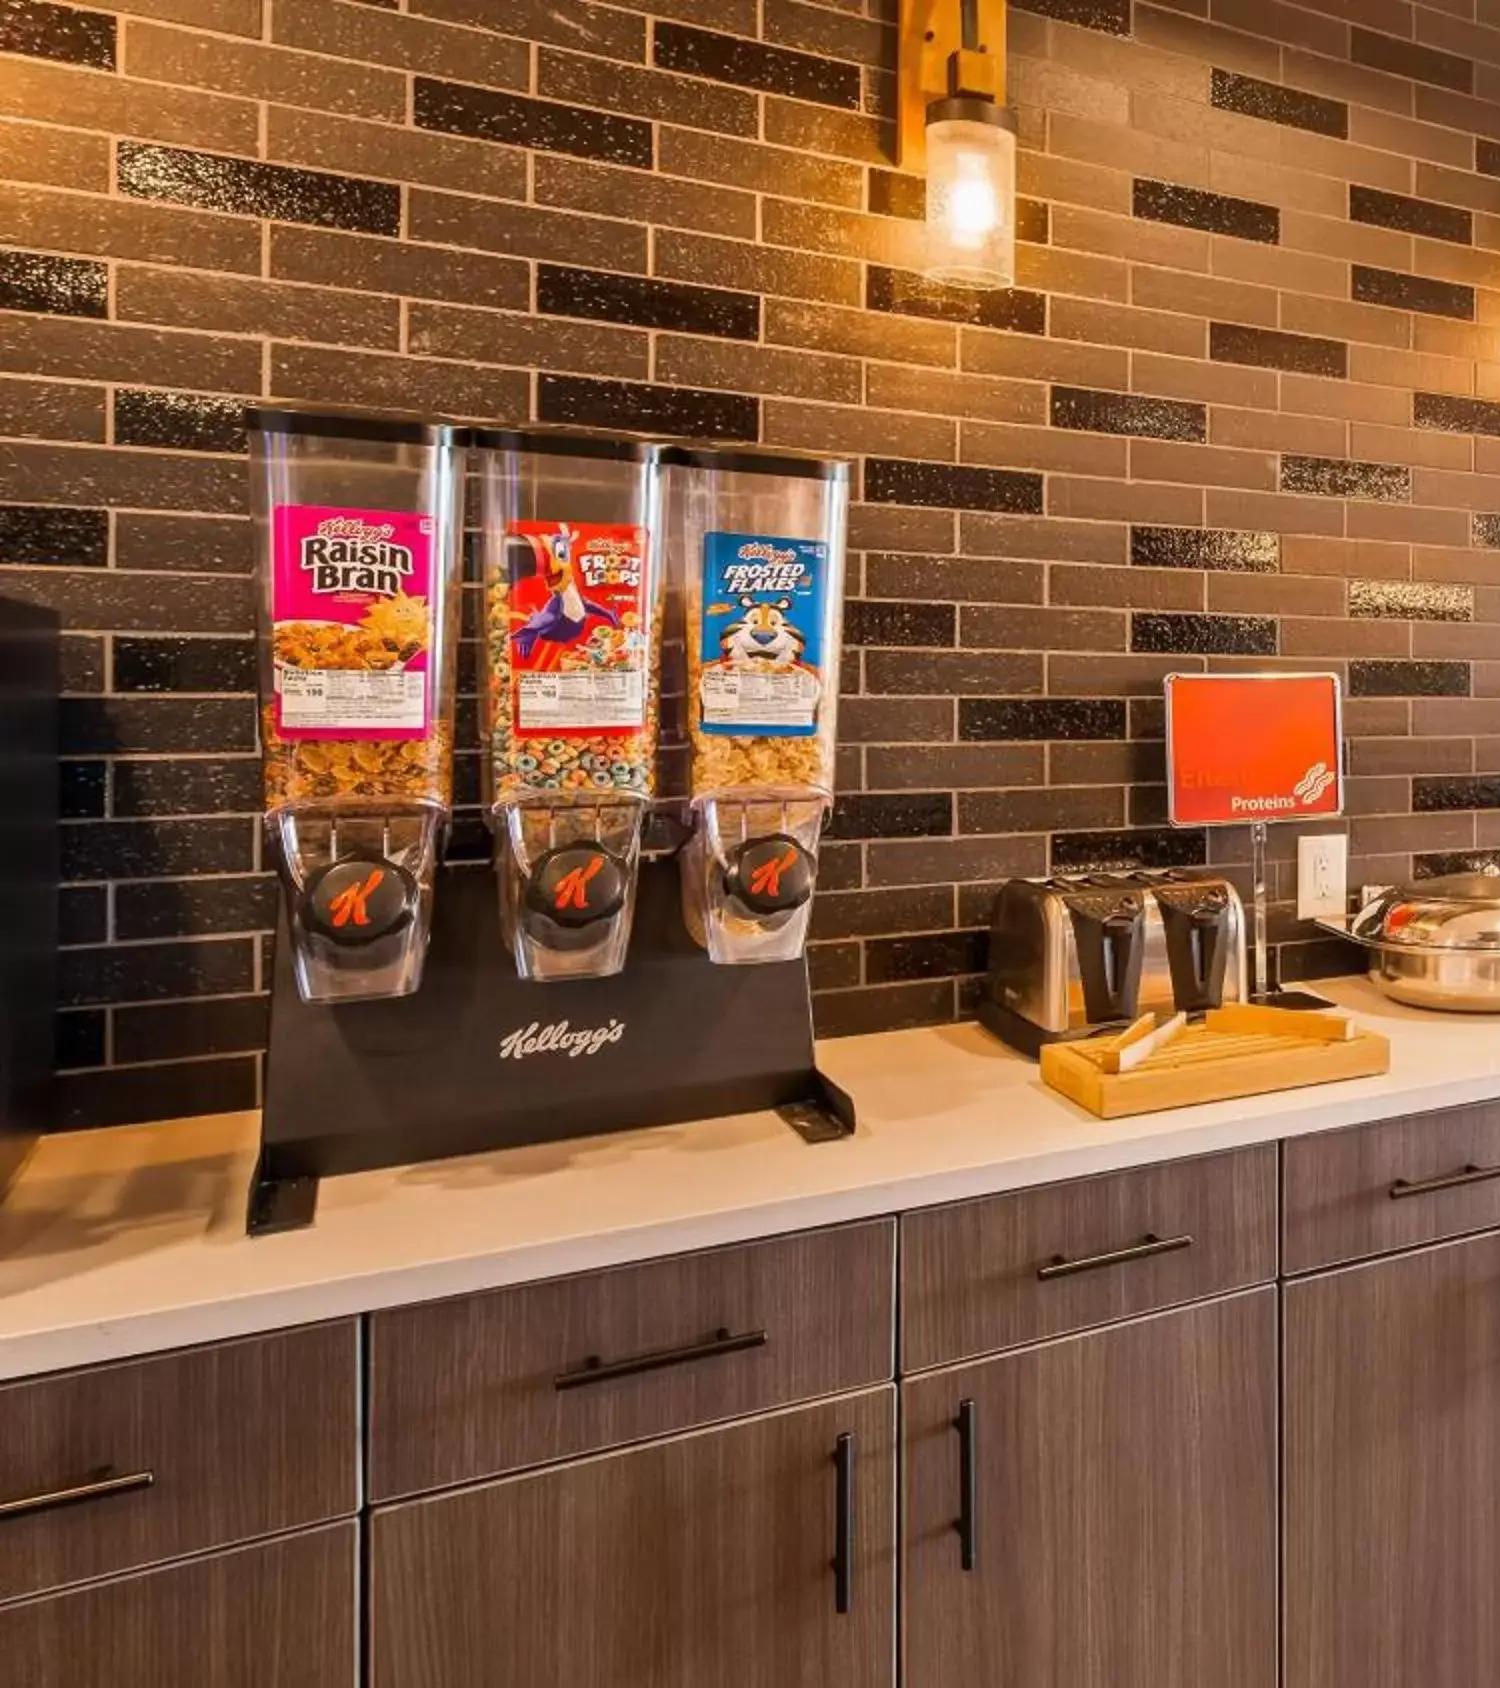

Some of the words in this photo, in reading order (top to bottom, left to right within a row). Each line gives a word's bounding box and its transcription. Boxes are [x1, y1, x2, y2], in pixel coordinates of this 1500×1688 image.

[318, 517, 395, 542] Kellogg's
[304, 537, 411, 572] Raisin
[579, 554, 641, 573] FROOT
[585, 570, 641, 587] LOOPS
[724, 563, 805, 580] FROSTED
[316, 564, 398, 599] Bran
[727, 578, 796, 593] FLAKES
[1231, 794, 1296, 812] Proteins
[500, 1018, 626, 1059] Kellogg's
